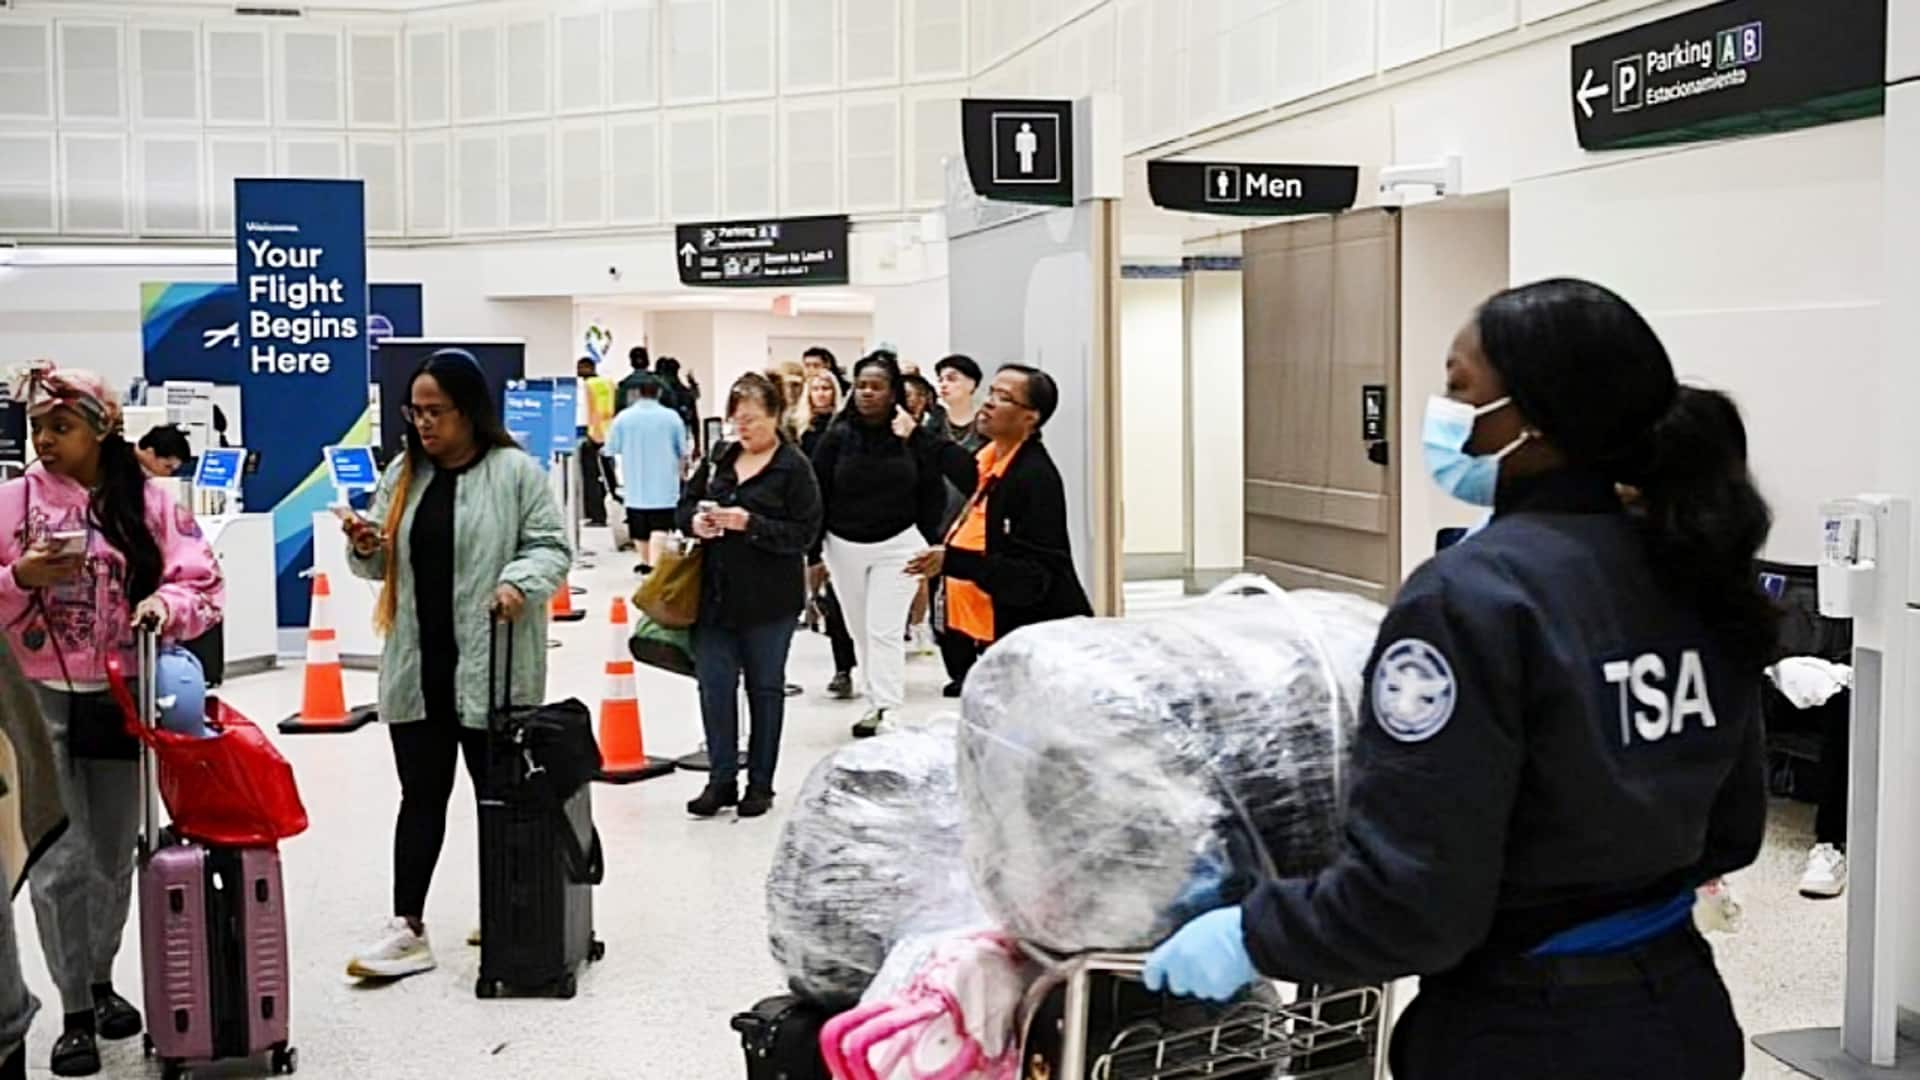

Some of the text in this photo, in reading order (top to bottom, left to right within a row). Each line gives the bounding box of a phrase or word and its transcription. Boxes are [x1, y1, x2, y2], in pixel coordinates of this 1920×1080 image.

[1646, 40, 1712, 74] Parking
[1722, 34, 1736, 63] A
[1744, 27, 1757, 57] B
[1646, 69, 1747, 104] Estacionamiento
[1246, 173, 1302, 198] Men
[248, 239, 323, 268] Your
[249, 273, 344, 310] Flight
[250, 309, 359, 345] Begins
[251, 344, 331, 374] Here
[1603, 650, 1717, 745] TSA
